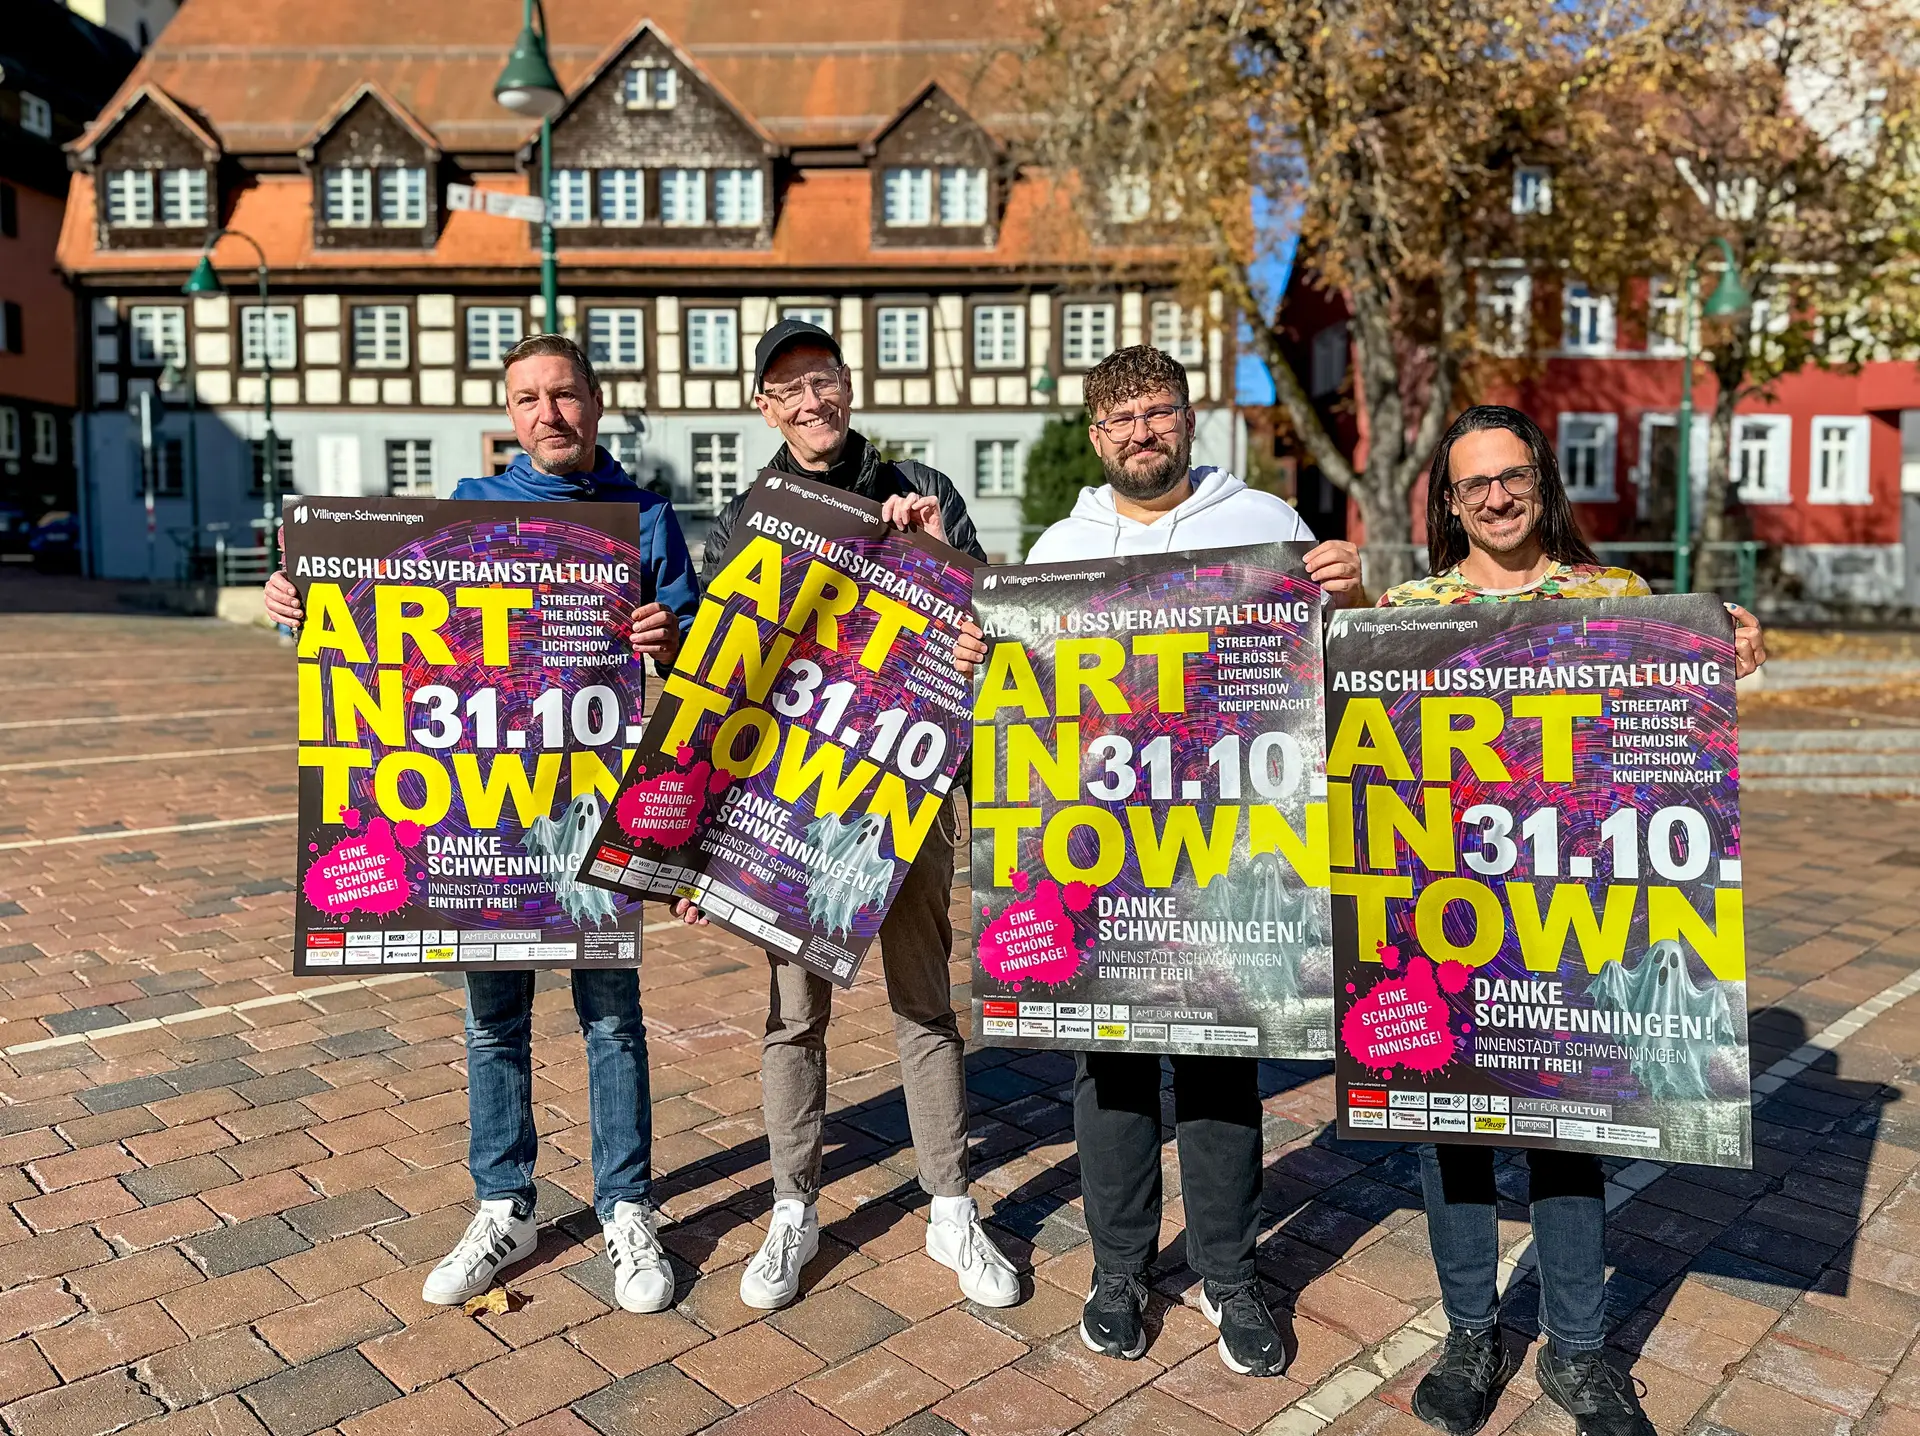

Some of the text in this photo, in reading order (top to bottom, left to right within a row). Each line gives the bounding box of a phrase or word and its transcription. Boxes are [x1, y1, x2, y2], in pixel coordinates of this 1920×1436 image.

[784, 481, 879, 526] Villingen-Schwenningen
[312, 508, 424, 524] Villingen-Schwenningen
[295, 555, 629, 584] ABSCHLUSSVERANSTALTUNG
[1001, 570, 1106, 586] Villingen-Schwenningen
[541, 595, 605, 606] STREETART
[708, 535, 929, 673] ART
[298, 582, 533, 667] ART
[542, 608, 609, 622] THE RÖSSLE
[983, 601, 1309, 638] ABCHLUSSVERANSTALTUNG
[542, 625, 604, 637] LIVEMUSIK
[1353, 618, 1478, 635] Villingen-Schwenningen
[542, 640, 610, 652] LICHTSHOW
[924, 640, 942, 657] THE
[1217, 636, 1283, 649] STREETART
[542, 654, 629, 668] KNEIPENNACHT
[1217, 650, 1288, 664] THE RÖSSLE
[916, 653, 967, 687] LIVEMUSIK
[973, 631, 1209, 720] ART
[1218, 667, 1282, 680] LIVEMUSIK
[1332, 662, 1721, 694] ABSCHLUSSVERANSTALTUNG
[910, 666, 966, 700] LICHTSHOW
[1218, 683, 1289, 696] LICHTSHOW
[298, 663, 643, 749] IN 31.10.
[671, 600, 953, 795] IN 31.10.
[903, 679, 974, 721] KNEIPENNACHT
[1218, 698, 1312, 712] KNEIPENNACHT
[1611, 699, 1689, 713] STREETART
[1612, 714, 1695, 731] THE RÖSSLE
[1327, 694, 1602, 783] ART
[1612, 735, 1688, 748] LIVEMUSIK
[660, 675, 943, 864] TOWN
[972, 721, 1327, 803] IN 31.10.
[1612, 753, 1697, 766] LICHTSHOW
[659, 780, 684, 793] EINE
[1613, 770, 1722, 783] KNEIPENNACHT
[638, 791, 696, 805] SCHAURIG-
[725, 785, 792, 830] DANKE
[643, 803, 687, 818] SCHÖNE
[631, 815, 690, 830] FINNISAGE!
[1328, 782, 1742, 881] IN 31.10.
[339, 845, 368, 861] EINE
[427, 836, 501, 855] DANKE
[715, 804, 879, 893] SCHWENNINGEN!
[972, 802, 1331, 889] TOWN
[322, 854, 390, 879] SCHAURIG-
[427, 853, 580, 876] SCHWENNING
[700, 840, 776, 885] EINTRITT FREI!
[706, 827, 850, 904] INNENSTADT SCHWENNINGEN
[335, 867, 386, 890] SCHÖNE
[428, 882, 500, 896] INNENSTADT
[328, 879, 399, 906] FINNISAGE!
[428, 897, 517, 909] EINTRITT FREI!
[714, 884, 731, 896] AMT
[741, 898, 775, 920] KULTUR
[1010, 908, 1037, 926] EINE
[1098, 896, 1176, 918] DANKE
[484, 931, 499, 940] FÜR
[500, 932, 537, 940] KULTUR
[994, 918, 1059, 945] SCHAURIG-
[1098, 919, 1304, 944] SCHWENNINGEN!
[1330, 873, 1746, 981] TOWN
[1006, 934, 1055, 957] SCHÖNE
[999, 946, 1068, 974] FINNISAGE!
[1098, 950, 1282, 967] INNENSTADT SCHWENNINGEN
[1098, 966, 1193, 981] EINTRITT FREI!
[1377, 988, 1408, 1006] EINE
[1474, 979, 1562, 1006] DANKE
[1136, 1009, 1214, 1020] AMT FÜR KULTUR
[1361, 1000, 1432, 1026] SCHAURIG-
[1474, 1003, 1712, 1041] SCHWENNINGEN!
[1375, 1015, 1428, 1040] SCHÖNE
[1367, 1030, 1442, 1059] FINNISAGE!
[1474, 1037, 1687, 1065] INNENSTADT SCHWENNINGEN
[1474, 1054, 1582, 1074] EINTRITT FREI!
[1517, 1102, 1607, 1117] AMT FÜR KULTUR
[1441, 1118, 1466, 1126] Kreative
[1517, 1120, 1549, 1130] apropos:
